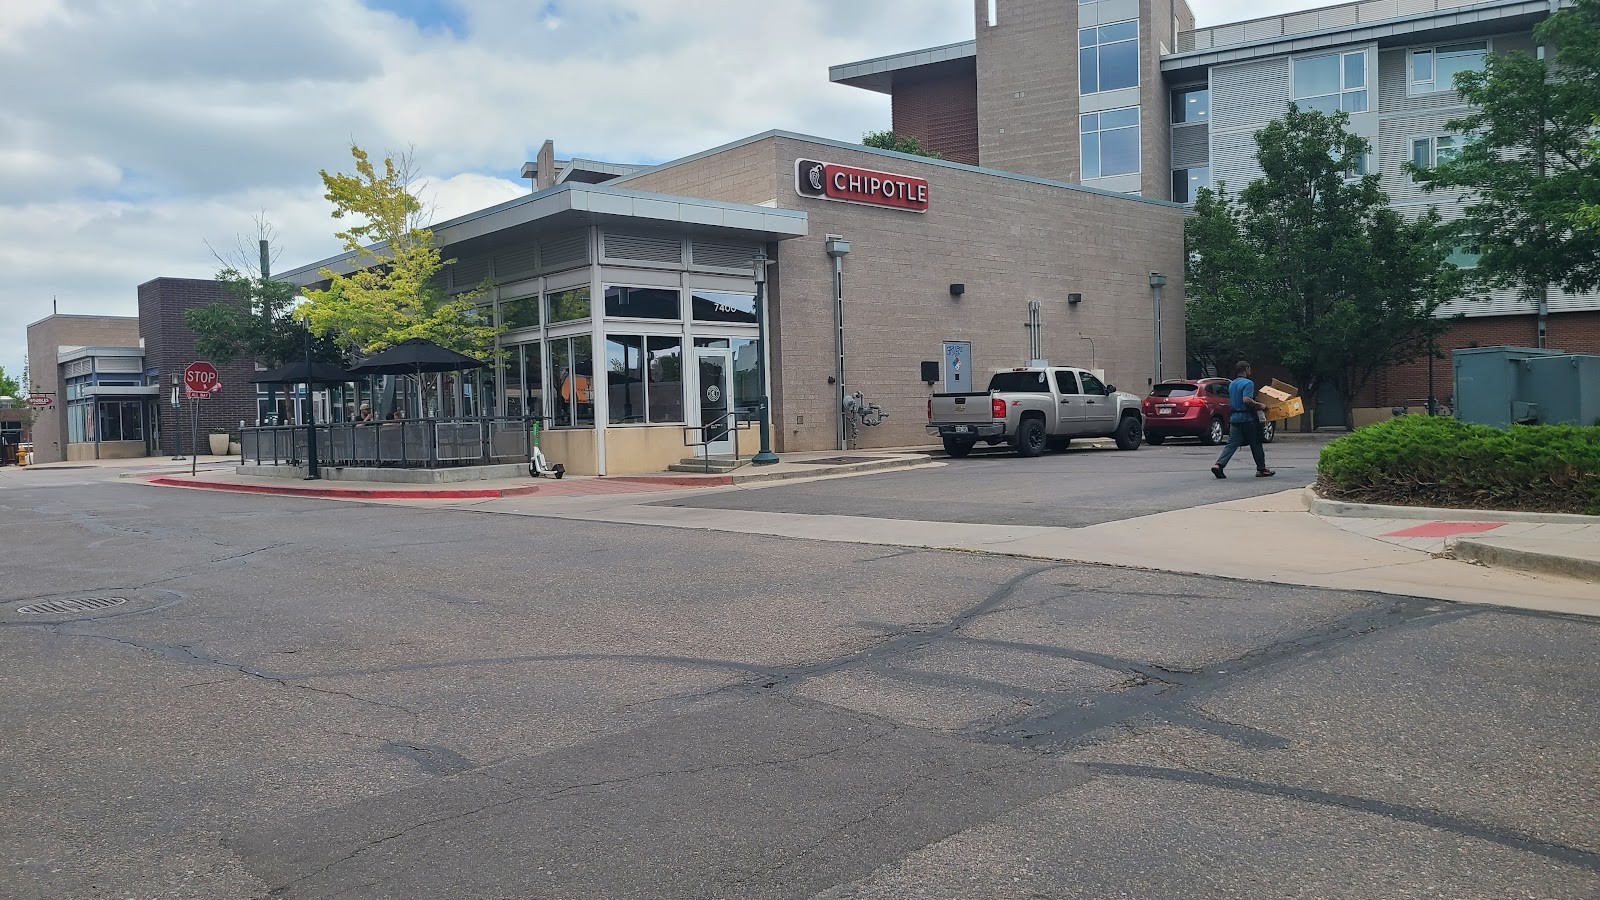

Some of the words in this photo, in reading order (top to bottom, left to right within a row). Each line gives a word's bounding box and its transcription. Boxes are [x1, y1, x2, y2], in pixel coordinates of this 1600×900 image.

[834, 171, 927, 202] CHIPOTLE
[714, 303, 737, 313] 7400
[187, 370, 216, 383] STOP
